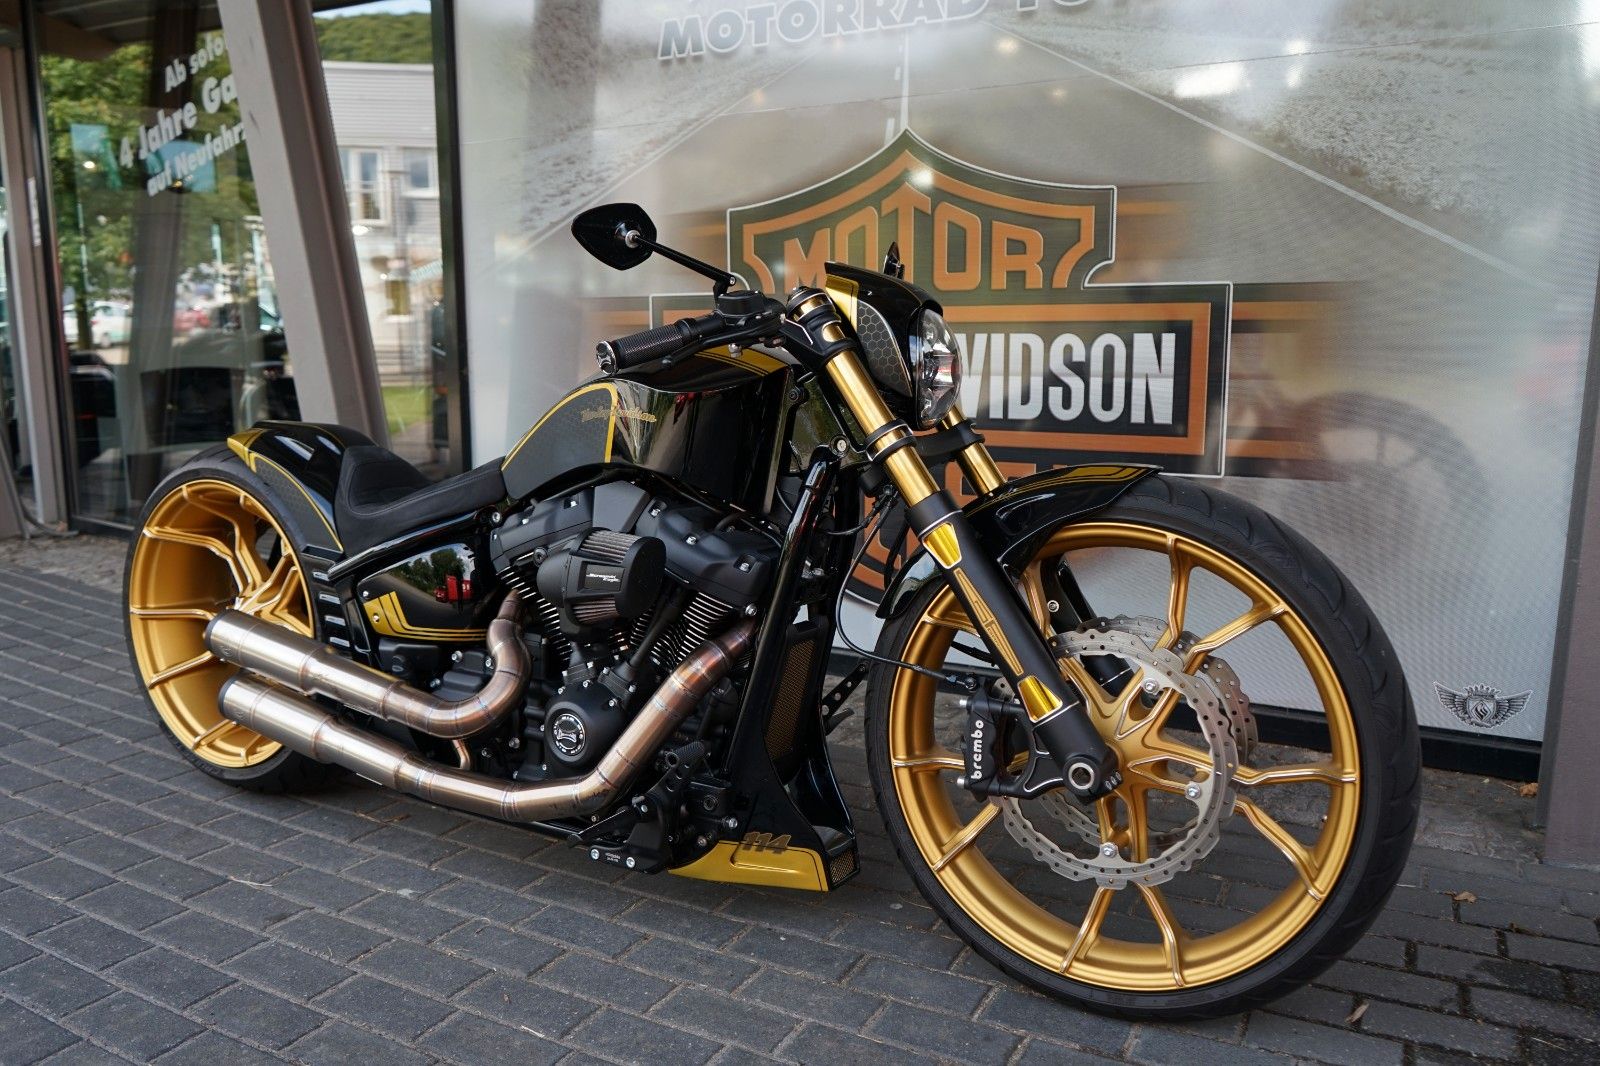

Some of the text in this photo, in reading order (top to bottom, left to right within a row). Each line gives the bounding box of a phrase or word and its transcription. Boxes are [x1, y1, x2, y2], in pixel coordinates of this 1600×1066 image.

[164, 34, 228, 93] Ab sofo
[119, 73, 238, 169] 4 Jahre Ga
[147, 159, 173, 197] auf
[784, 182, 1044, 295] MOTOR
[954, 332, 1176, 425] VIDSON
[971, 719, 985, 780] brembo
[743, 831, 792, 855] 114
